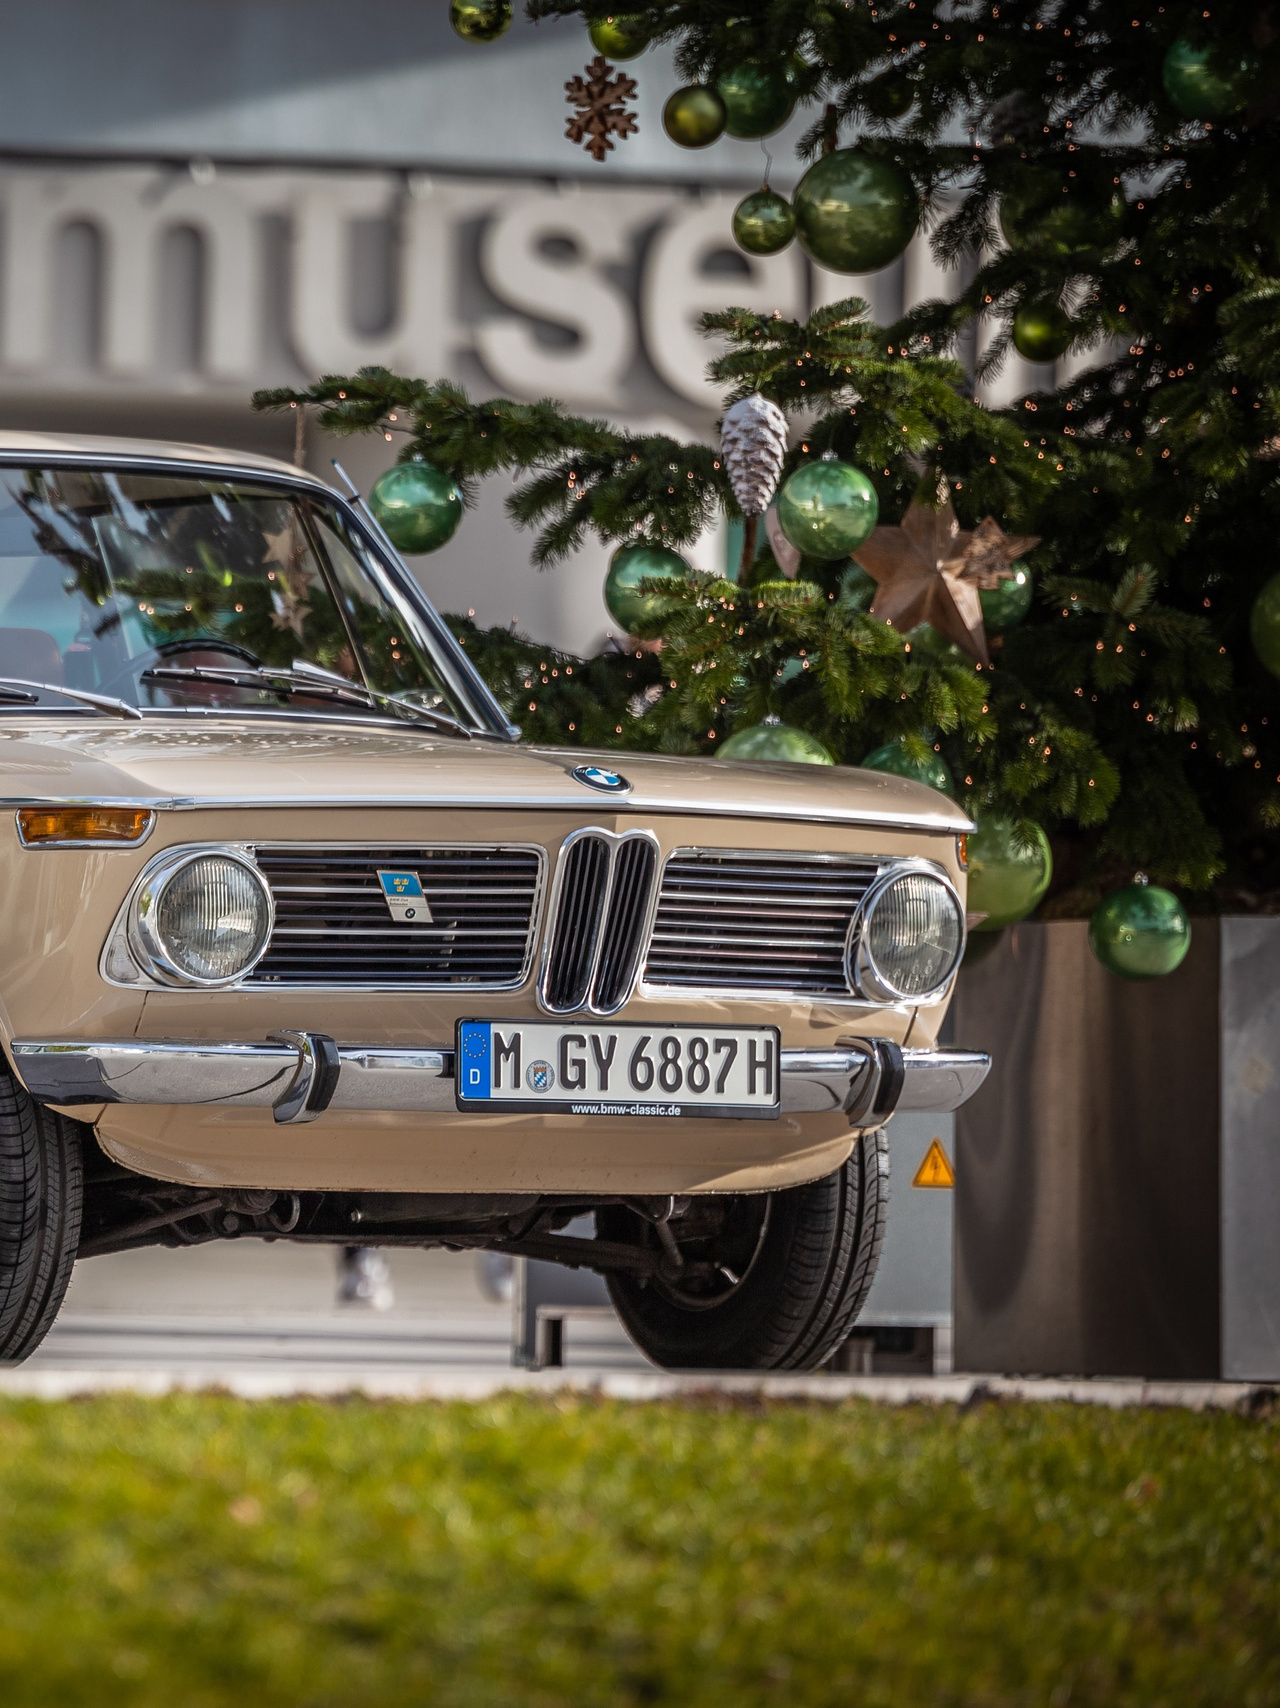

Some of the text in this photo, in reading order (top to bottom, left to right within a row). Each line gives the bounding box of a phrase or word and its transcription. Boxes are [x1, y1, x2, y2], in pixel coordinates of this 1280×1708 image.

[494, 1032, 521, 1088] M
[560, 1035, 617, 1091] GY
[469, 1068, 480, 1084] D
[571, 1104, 681, 1116] www.bmw-classic.de
